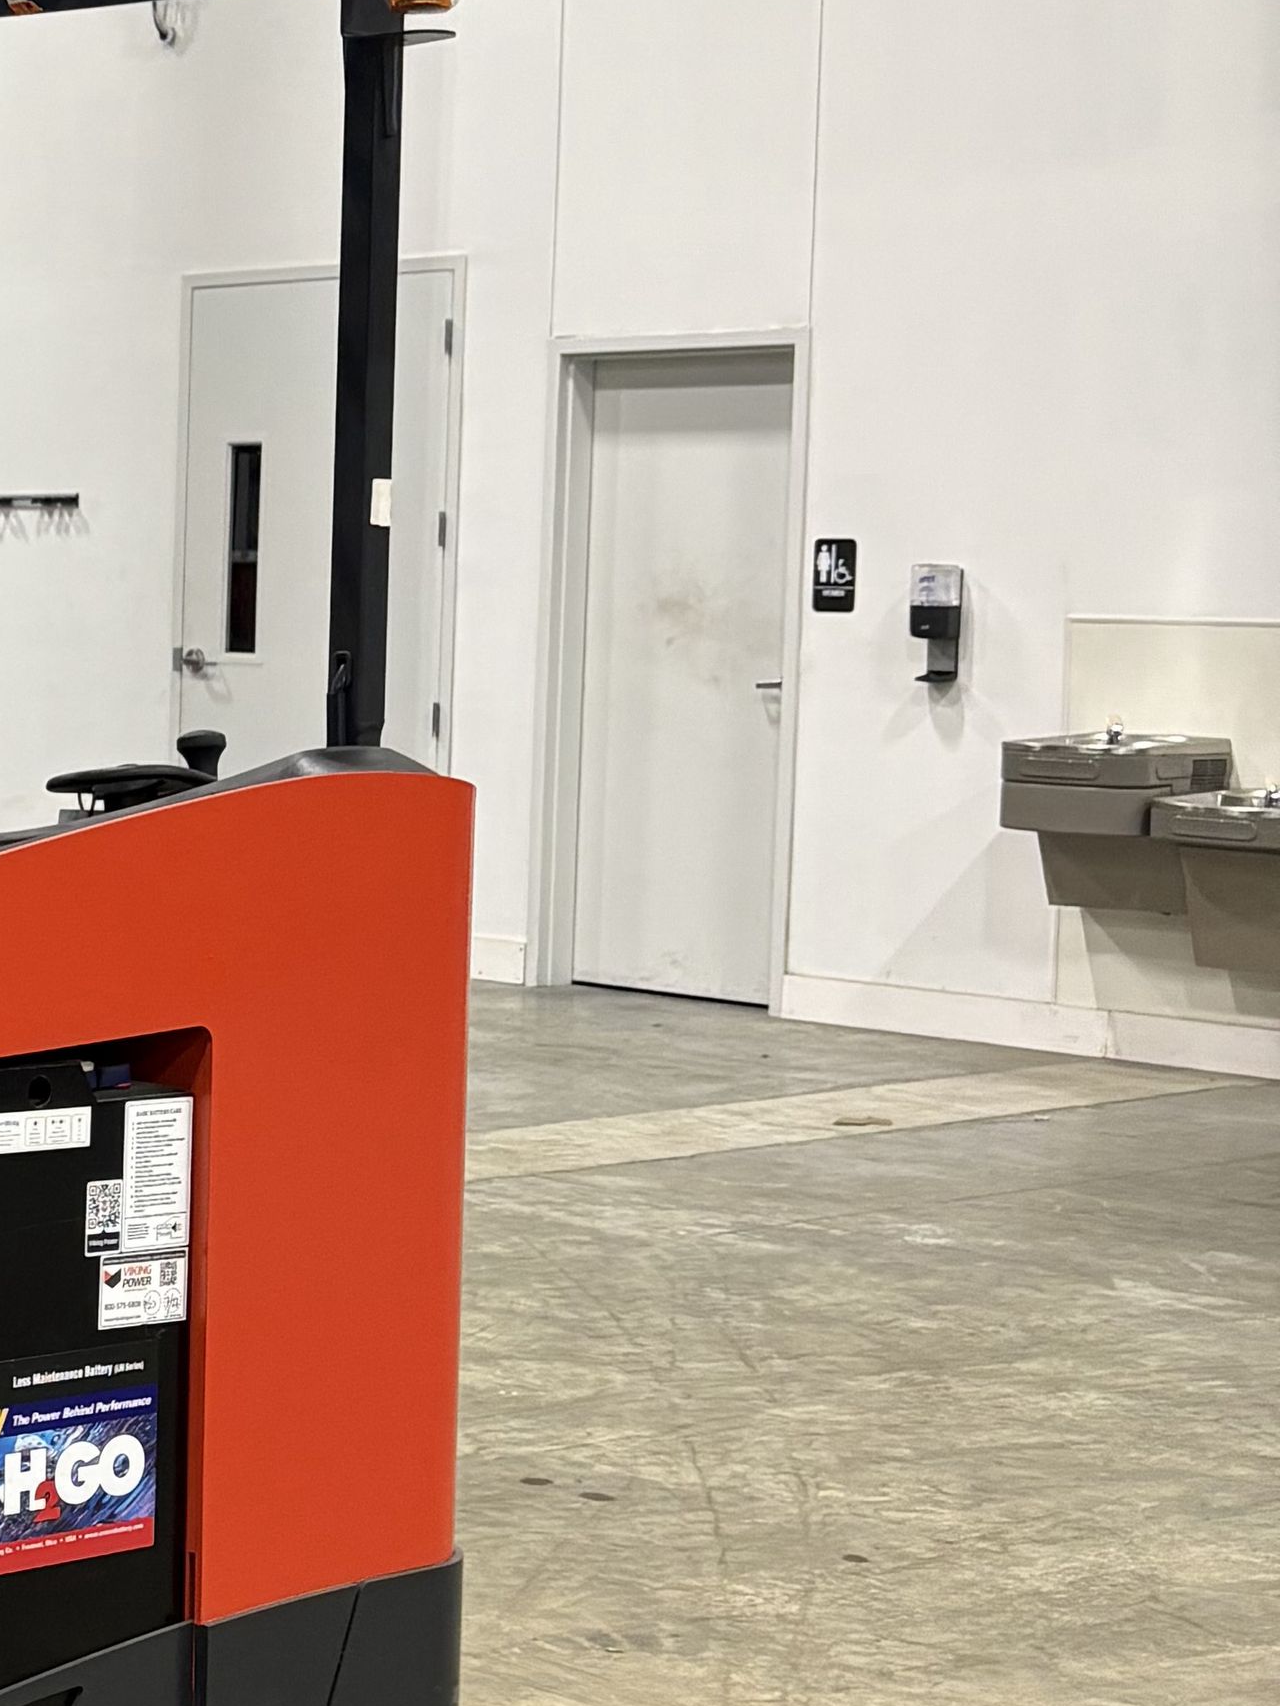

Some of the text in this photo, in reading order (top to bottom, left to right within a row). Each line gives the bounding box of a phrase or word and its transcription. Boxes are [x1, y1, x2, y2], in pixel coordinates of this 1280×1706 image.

[122, 1276, 152, 1288] POWER
[12, 1376, 31, 1389] Less
[32, 1368, 83, 1386] Maintenance
[84, 1362, 114, 1380] Battery
[13, 1395, 153, 1427] The Power Behind Performance
[3, 1434, 146, 1523] H2GO
